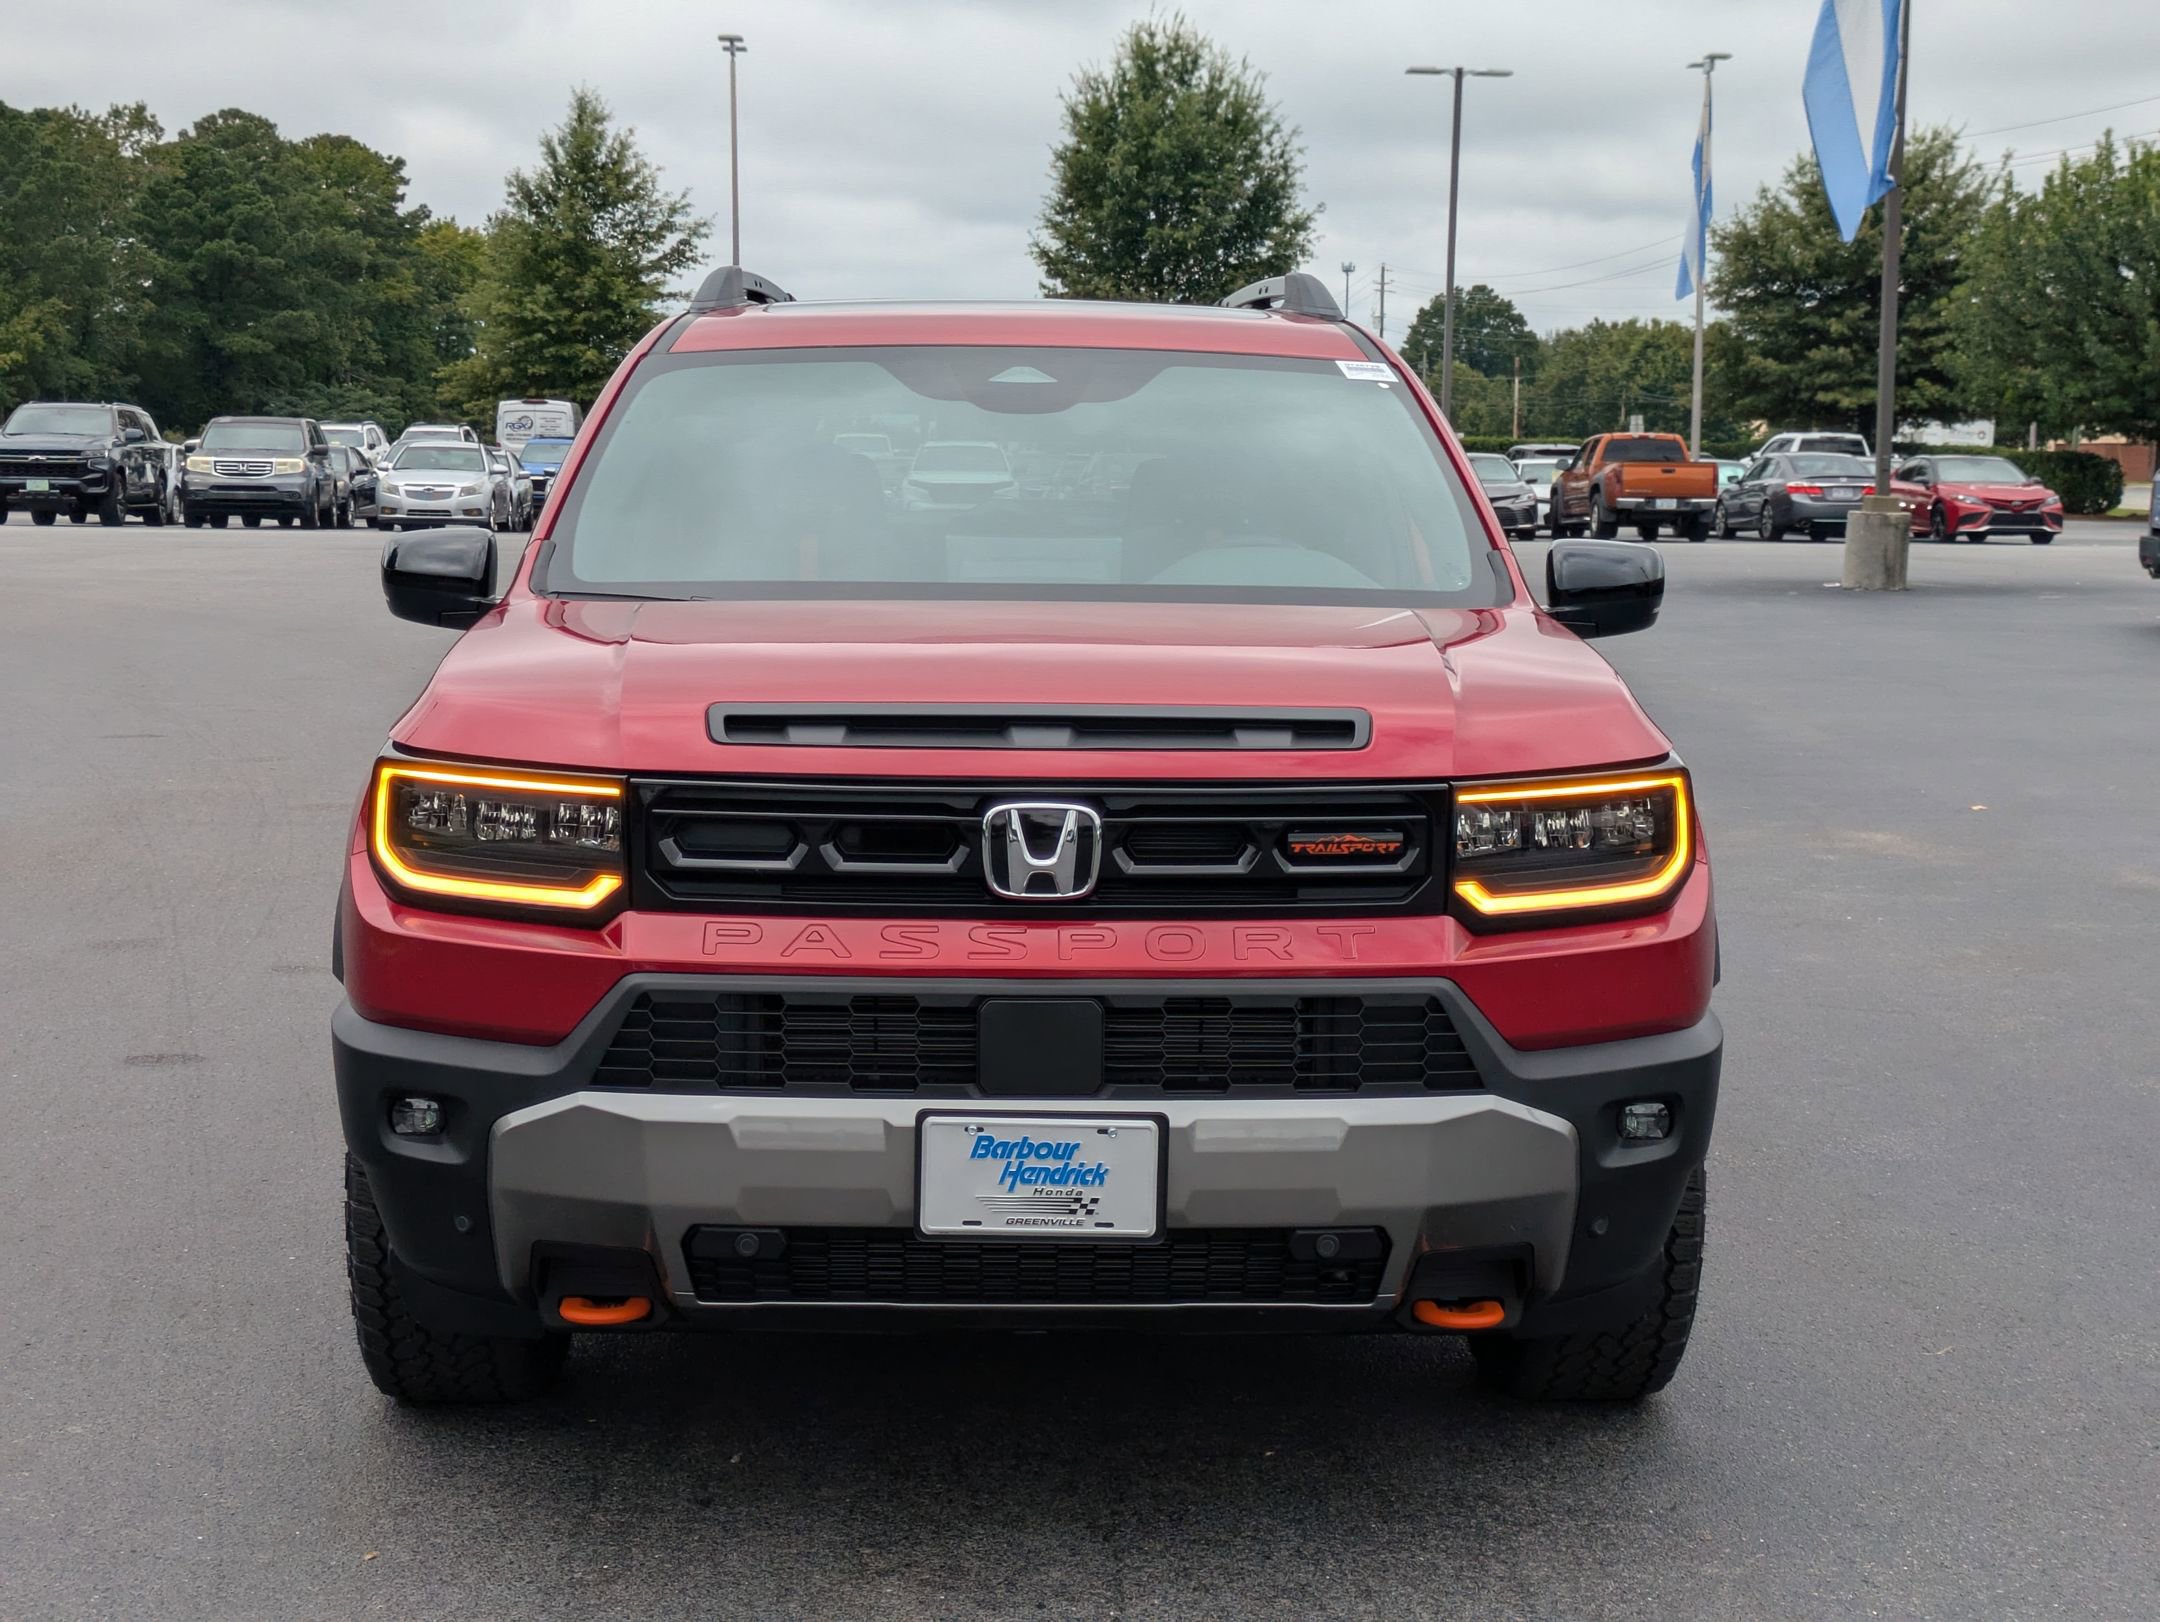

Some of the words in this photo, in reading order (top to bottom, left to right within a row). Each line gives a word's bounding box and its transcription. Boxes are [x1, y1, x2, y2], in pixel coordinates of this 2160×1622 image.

[1291, 843, 1400, 854] TRAILSPORT
[701, 920, 1376, 962] PASSPORT
[968, 1134, 1081, 1160] Barbour
[997, 1160, 1110, 1193] Hendrick
[1032, 1187, 1084, 1197] Honda
[1005, 1217, 1087, 1227] GREENVILLE
